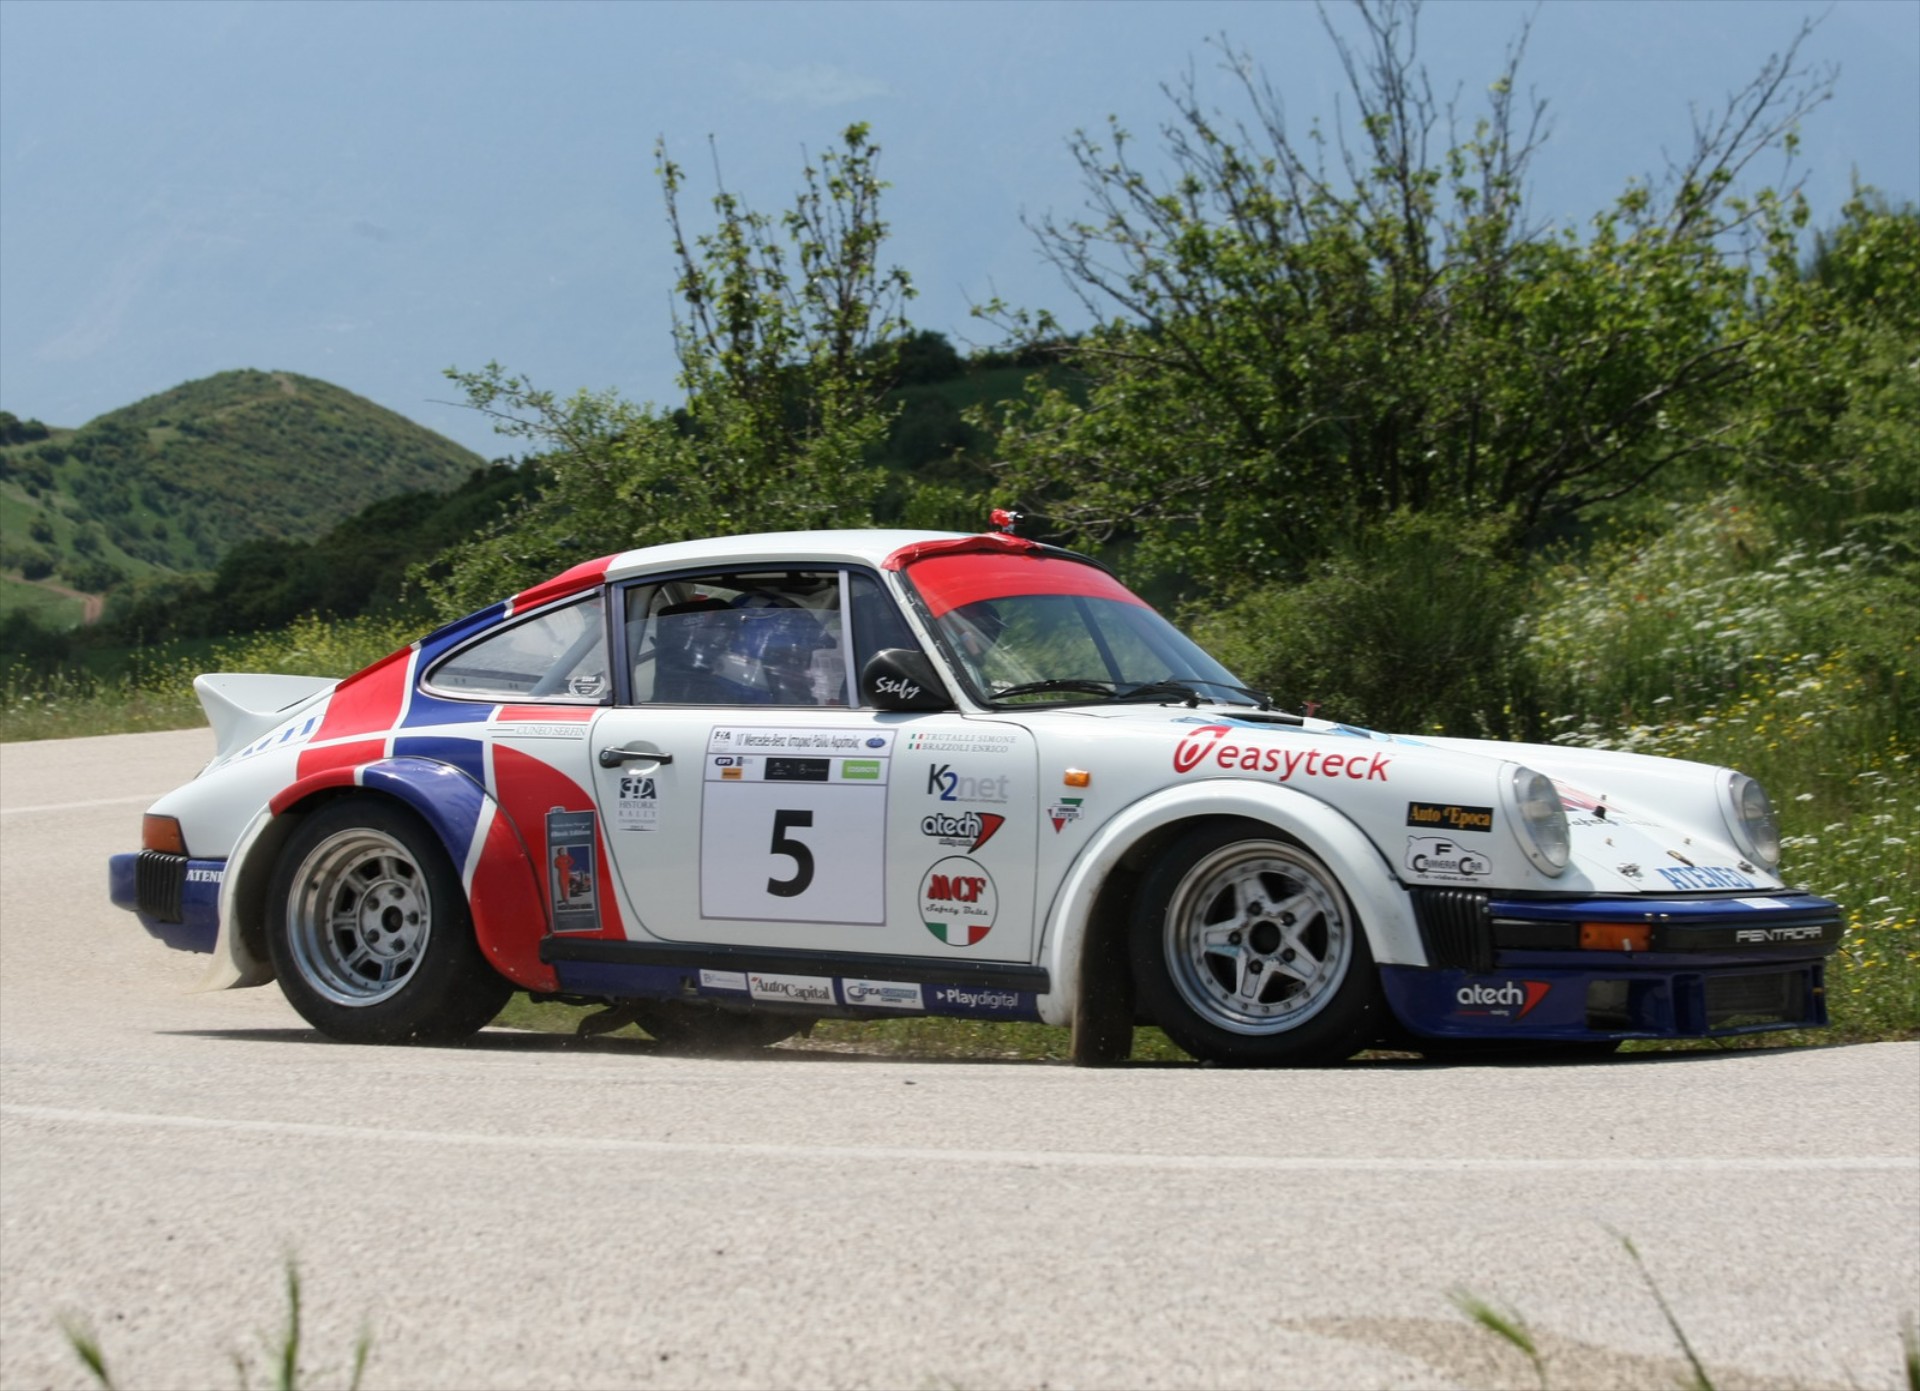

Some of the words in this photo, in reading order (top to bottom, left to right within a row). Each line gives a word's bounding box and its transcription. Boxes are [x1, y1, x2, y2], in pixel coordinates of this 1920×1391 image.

[876, 677, 920, 699] Stefy
[516, 726, 552, 735] CUNEO
[552, 727, 587, 736] SERFIN
[925, 734, 974, 742] TRUTALLI
[977, 735, 1016, 744] SIMONE
[922, 743, 970, 752] BRAZZOLI
[971, 744, 1008, 753] ENRICO
[1216, 744, 1393, 782] easyteck
[619, 777, 656, 799] FIA
[927, 764, 1009, 801] K2net
[619, 801, 656, 809] HISTORIC
[1410, 805, 1441, 822] Auto
[922, 812, 981, 838] atech
[767, 809, 815, 898] 5
[1435, 843, 1452, 856] F
[927, 873, 987, 903] MCF
[1736, 926, 1822, 942] PENTACAR
[754, 978, 830, 1000] AutoCapital
[1456, 981, 1524, 1005] atech
